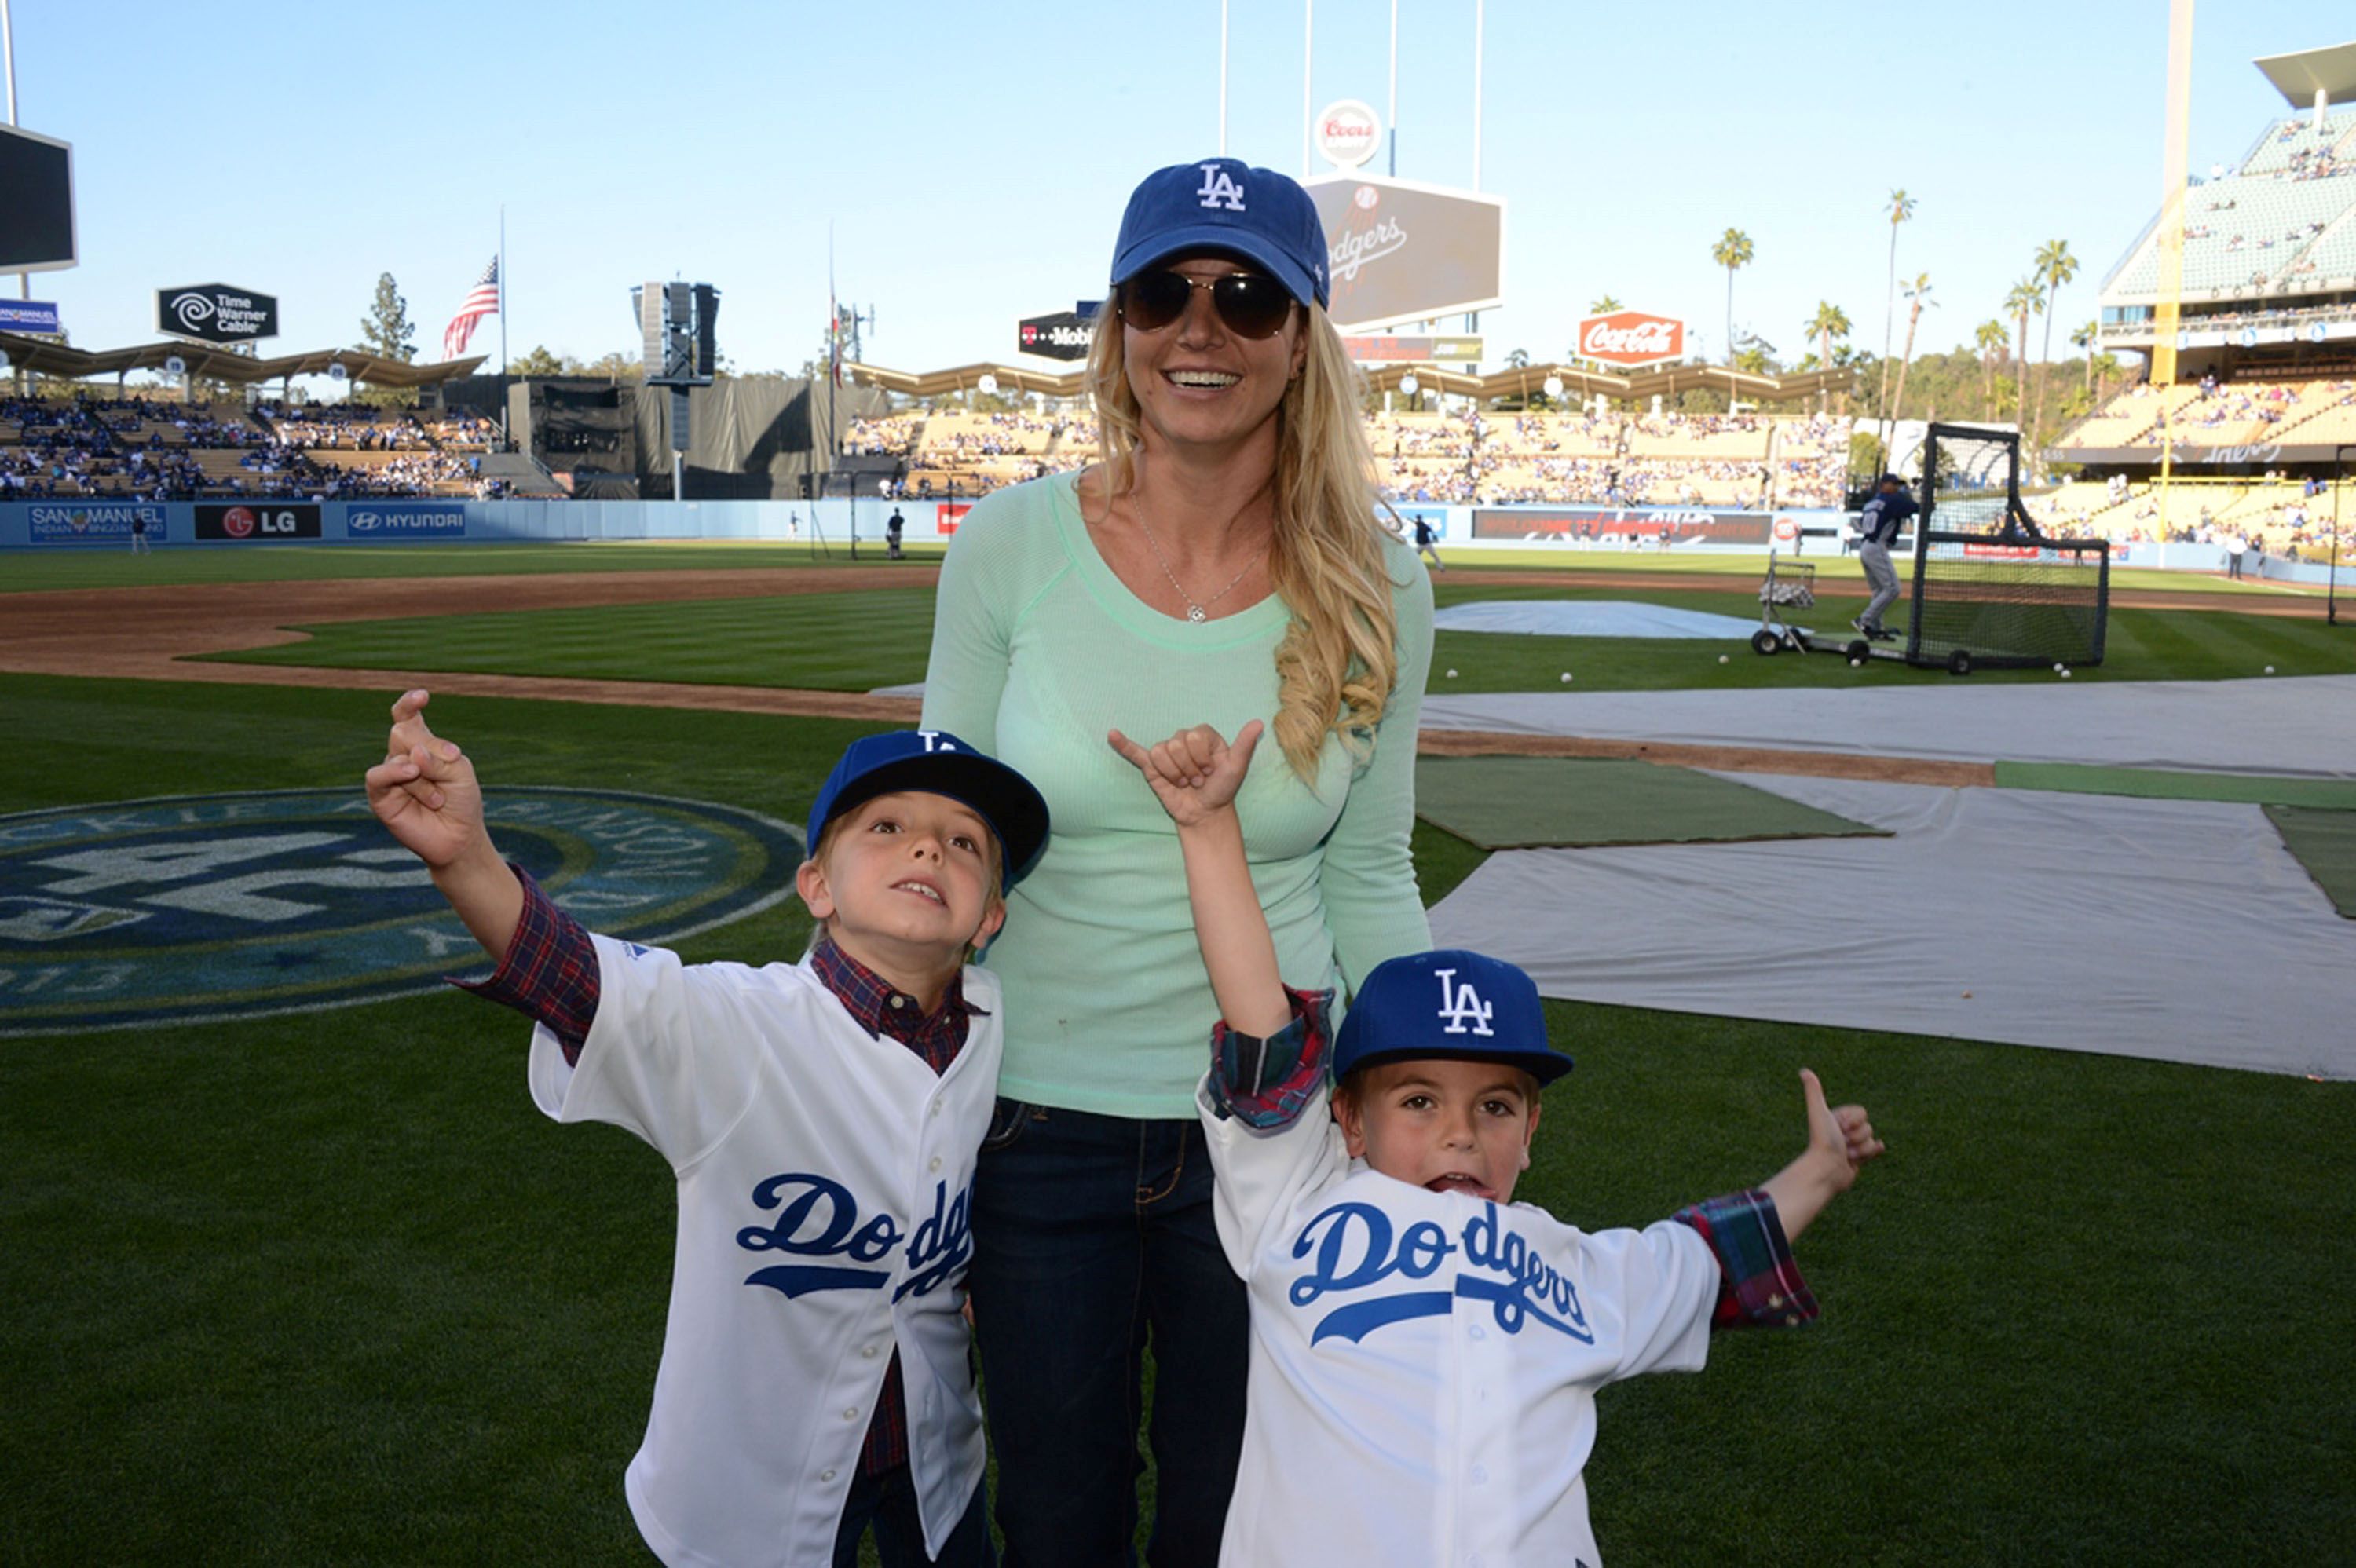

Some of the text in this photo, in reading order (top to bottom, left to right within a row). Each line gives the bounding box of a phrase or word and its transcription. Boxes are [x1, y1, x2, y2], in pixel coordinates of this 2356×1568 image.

[1325, 119, 1372, 137] Coors
[1197, 164, 1246, 211] LA
[216, 294, 251, 308] Time
[216, 308, 267, 321] Warner
[216, 320, 258, 333] Cable
[32, 508, 162, 524] SAN MANUEL
[261, 512, 296, 532] LG
[386, 514, 463, 528] HYUNDAI
[0, 802, 271, 842] CKIE
[28, 831, 510, 923] 42
[1434, 968, 1494, 1036] LA
[737, 1173, 972, 1297] Dodg
[1290, 1201, 1594, 1340] Dodgers
